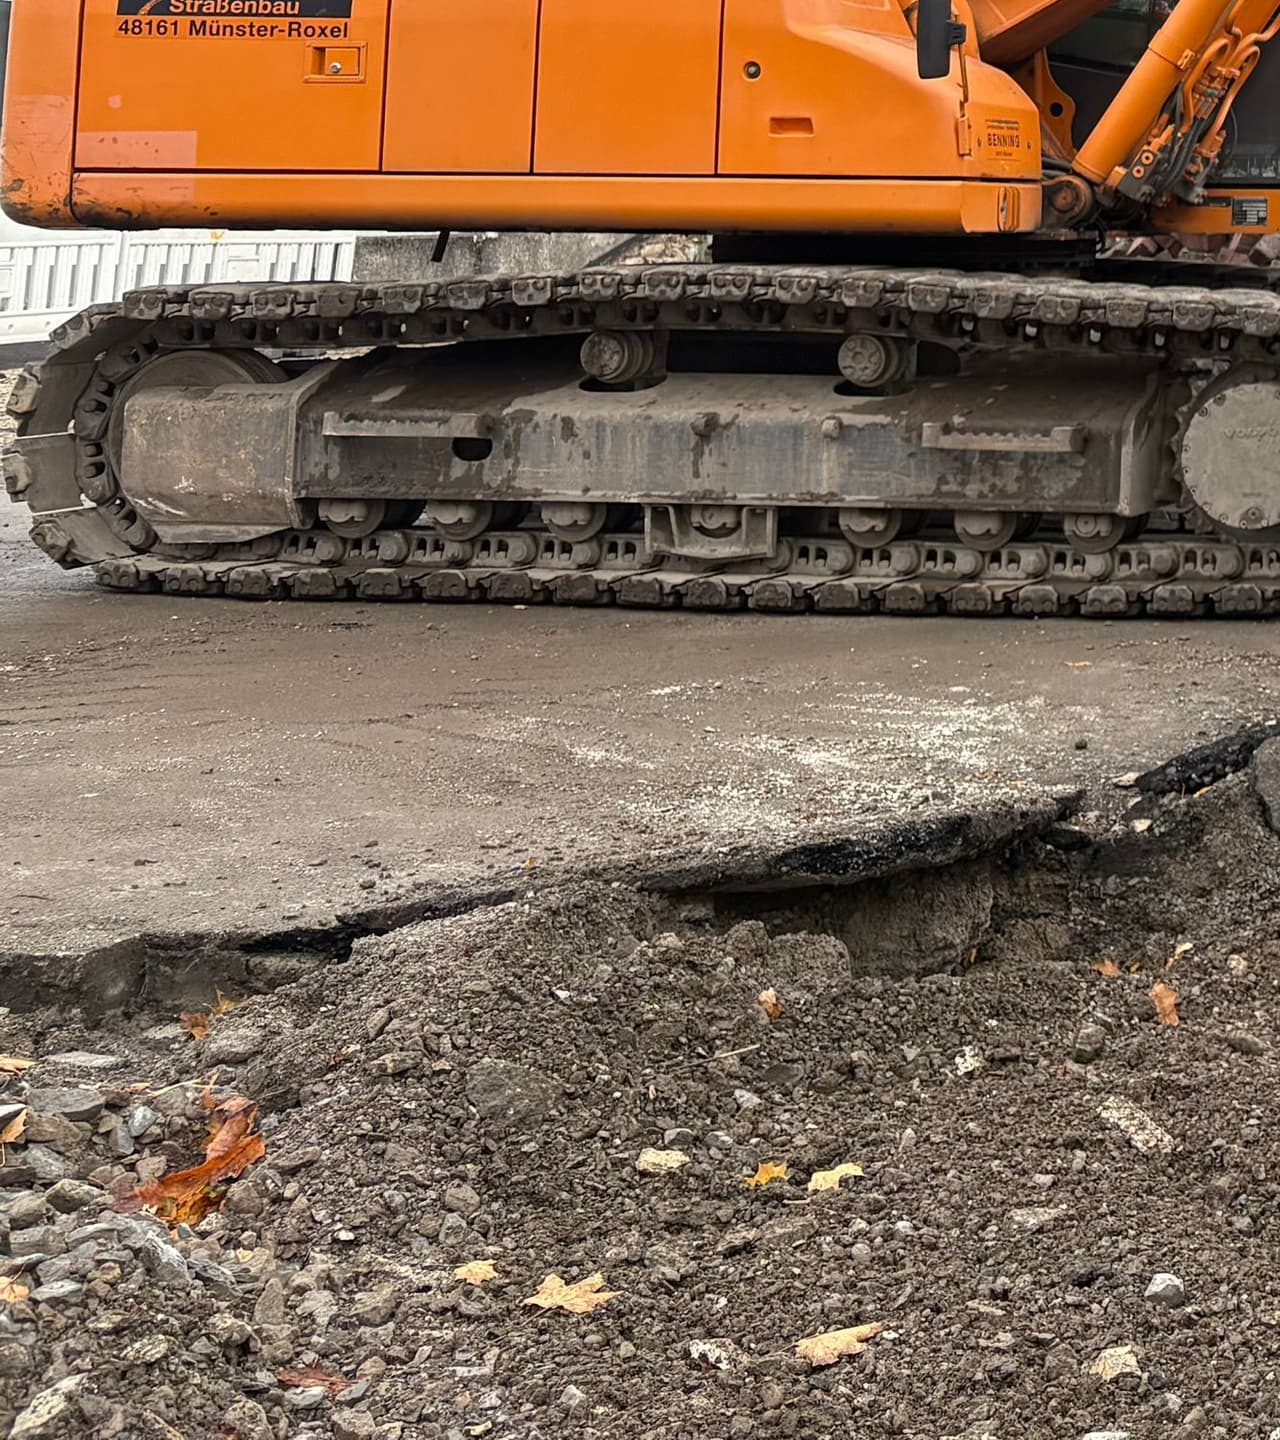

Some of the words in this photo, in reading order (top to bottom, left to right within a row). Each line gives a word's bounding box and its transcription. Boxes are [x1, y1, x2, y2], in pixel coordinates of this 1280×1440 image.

[117, 18, 179, 36] 48161
[188, 18, 349, 39] Münster-Roxel
[987, 132, 1021, 149] BENNING
